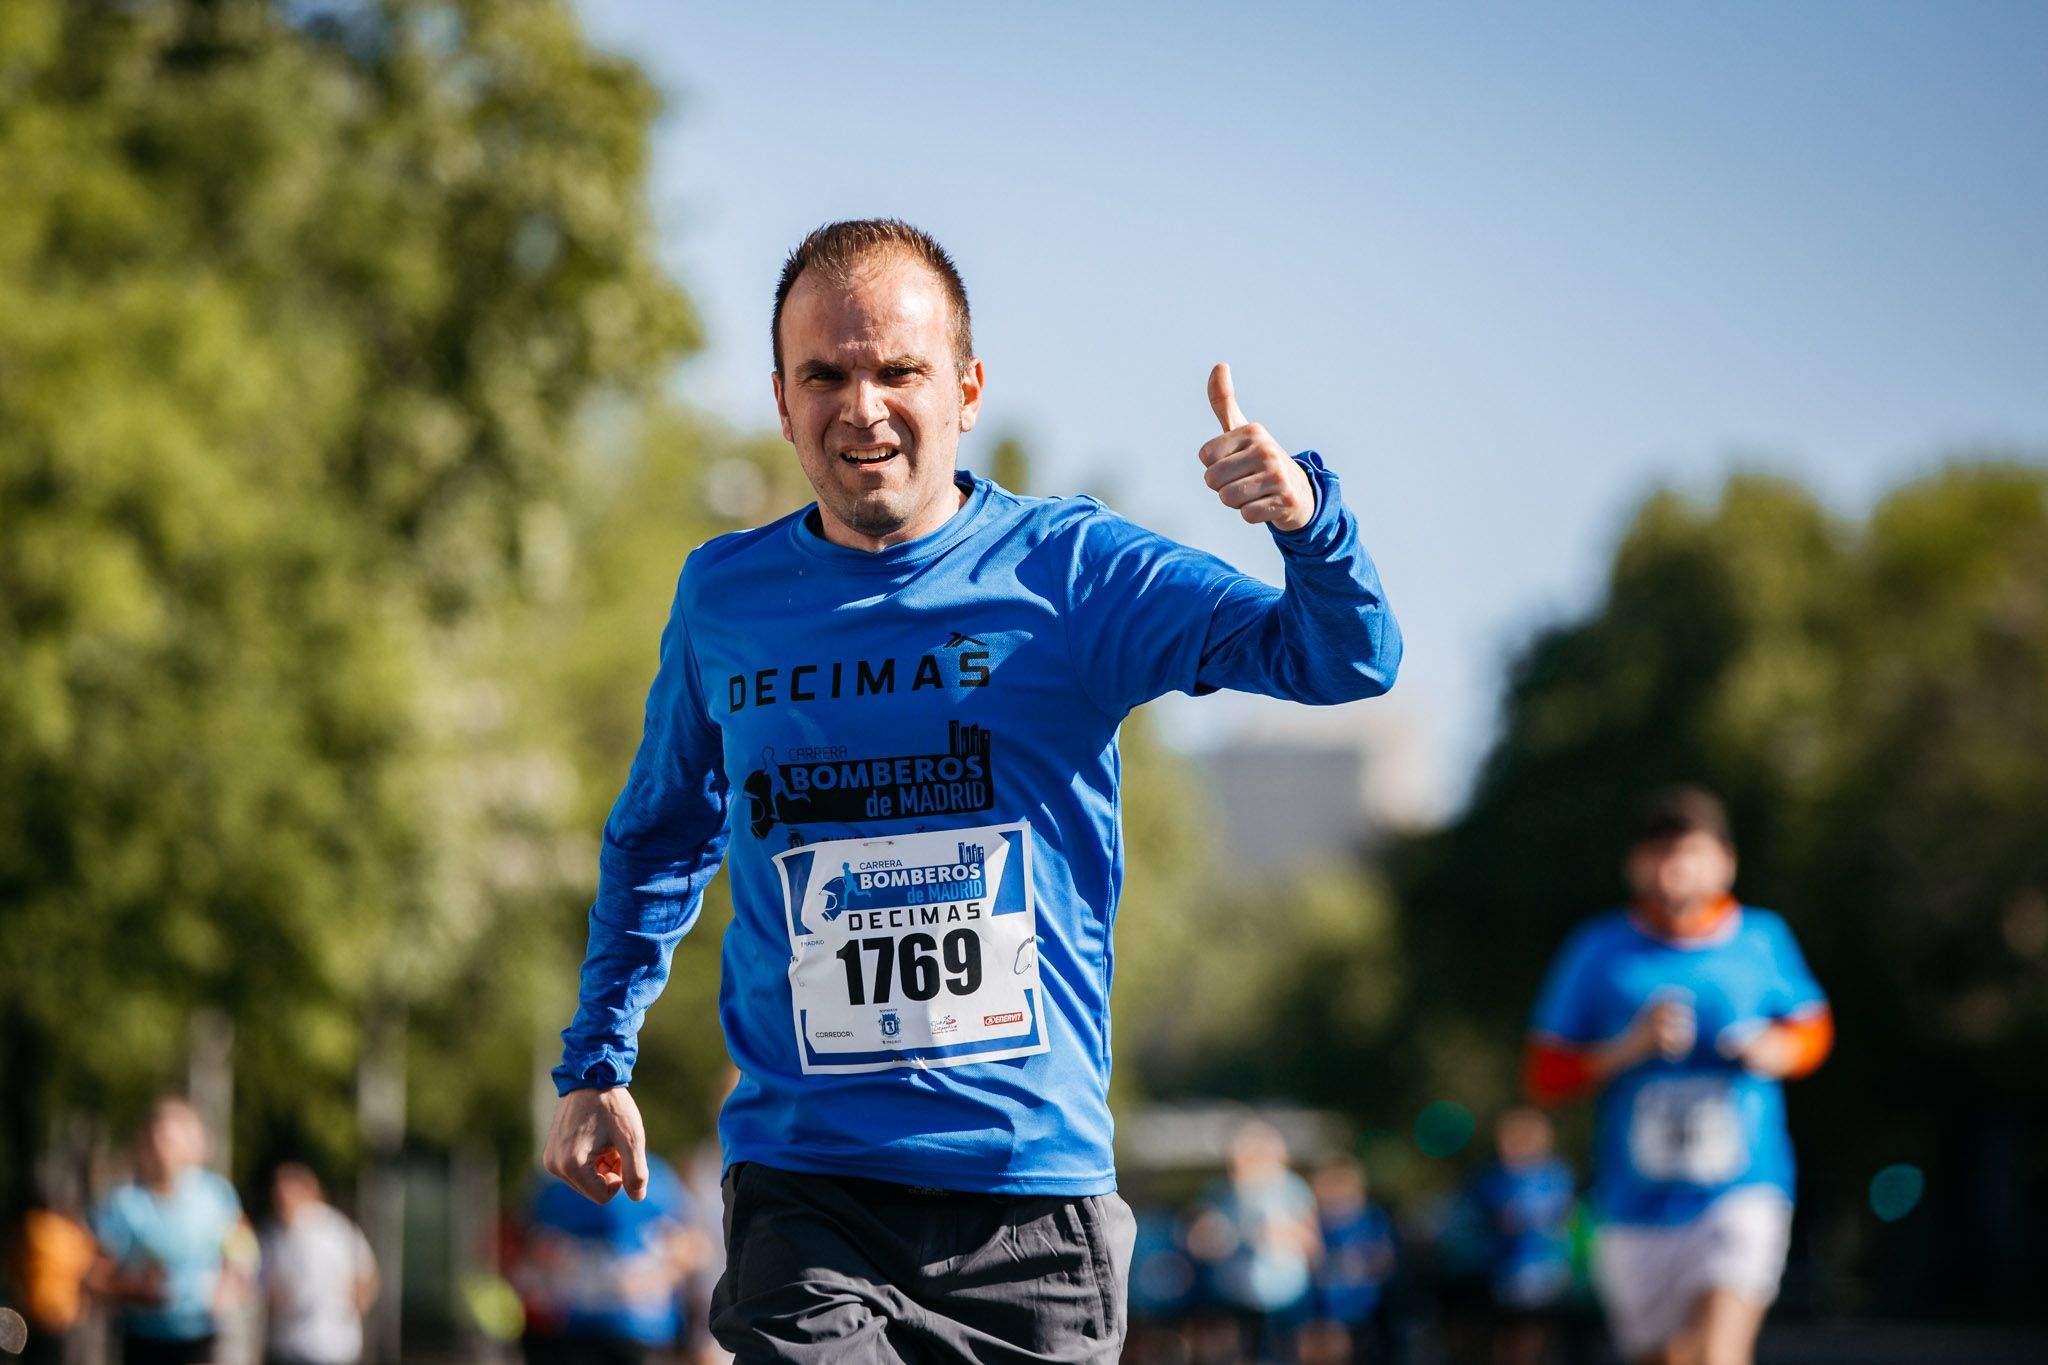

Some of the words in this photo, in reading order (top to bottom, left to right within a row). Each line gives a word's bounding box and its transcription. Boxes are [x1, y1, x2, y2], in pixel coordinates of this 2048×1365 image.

[729, 651, 990, 713] DECIMAS
[788, 745, 848, 761] CARRERA
[790, 755, 984, 792] BOMBEROS
[866, 790, 892, 817] de
[900, 781, 986, 815] MADRID
[859, 859, 903, 871] CARRERA
[860, 862, 981, 890] BOMBEROS
[907, 887, 925, 904] de
[927, 879, 983, 902] MADRID
[849, 902, 981, 931] DECIMAS
[836, 928, 983, 1006] 1769
